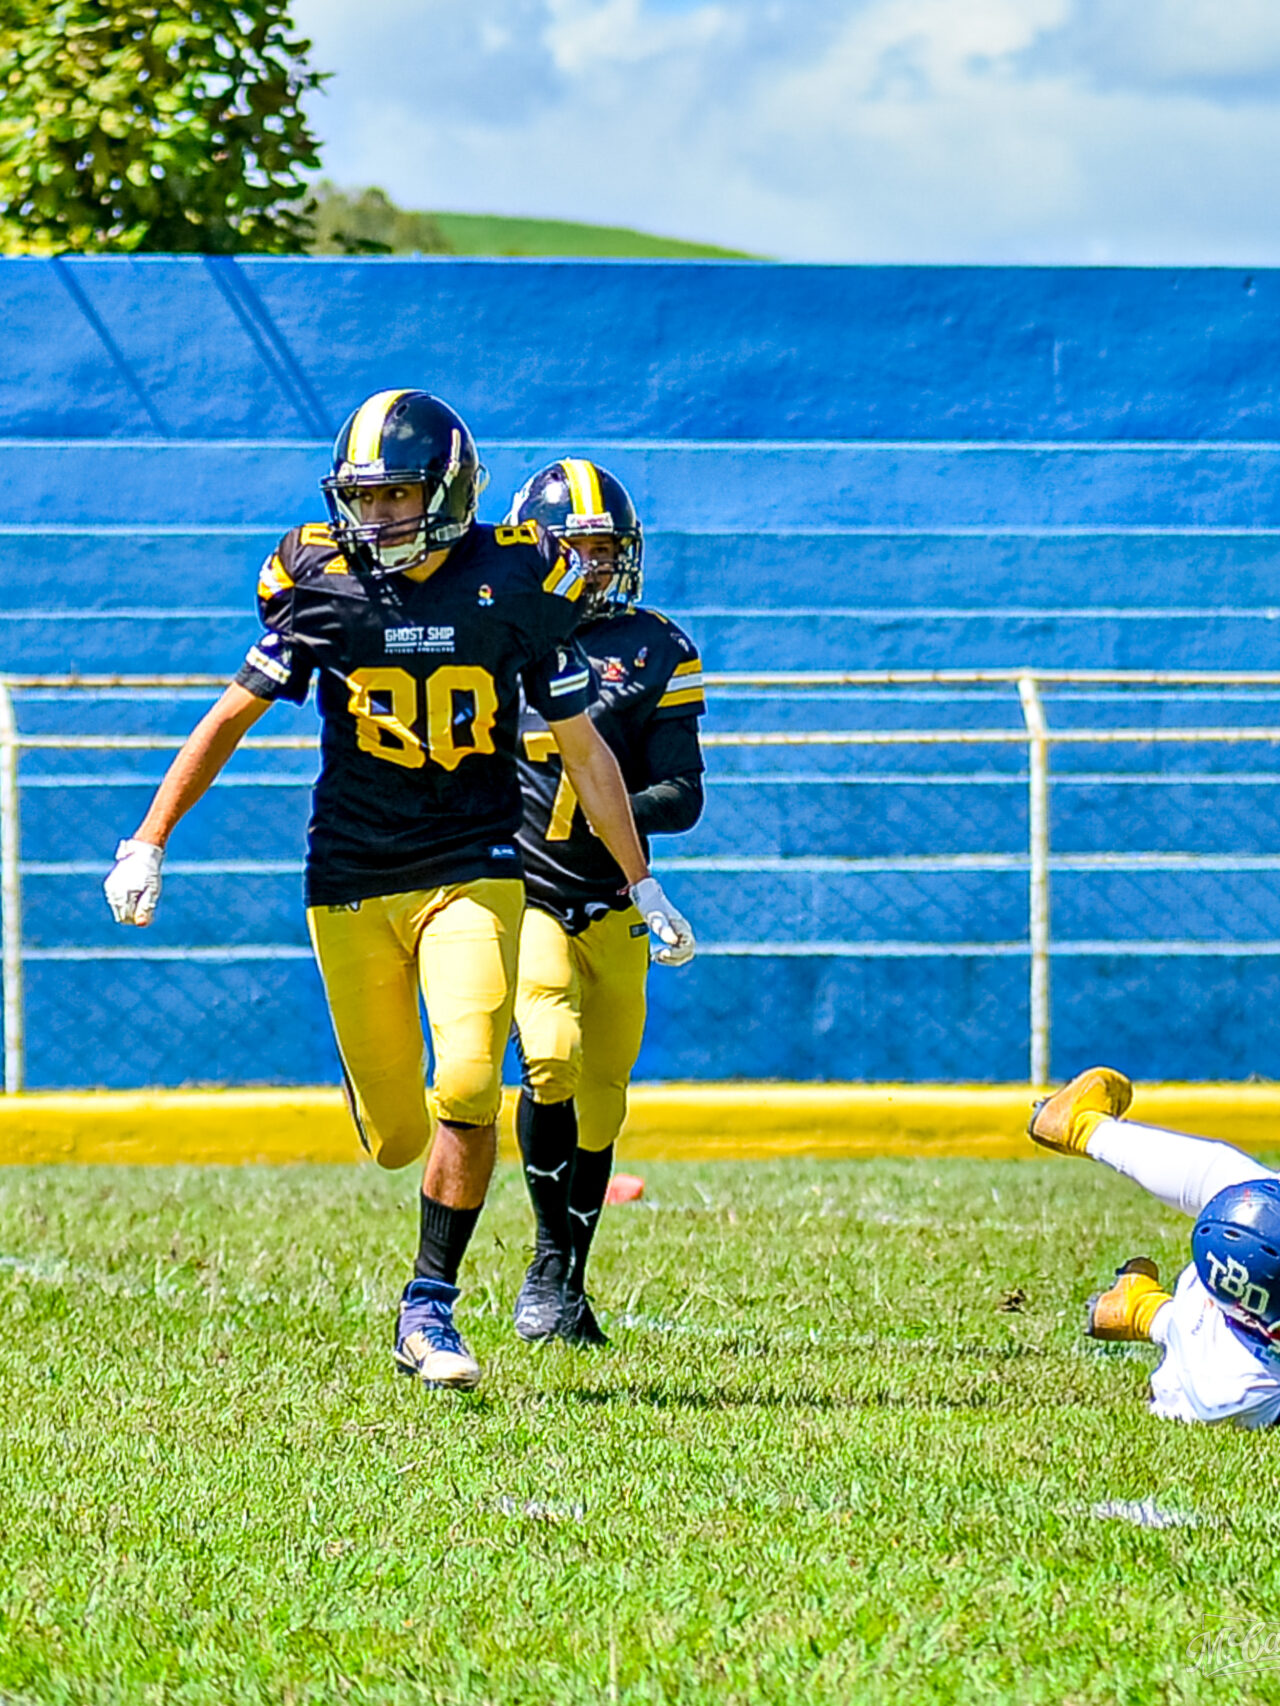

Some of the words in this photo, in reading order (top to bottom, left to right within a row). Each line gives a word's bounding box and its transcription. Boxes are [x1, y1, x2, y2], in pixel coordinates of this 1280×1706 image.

[384, 626, 424, 642] GHOST
[427, 626, 455, 641] SHIP
[346, 664, 499, 772] 80
[522, 731, 578, 841] 7
